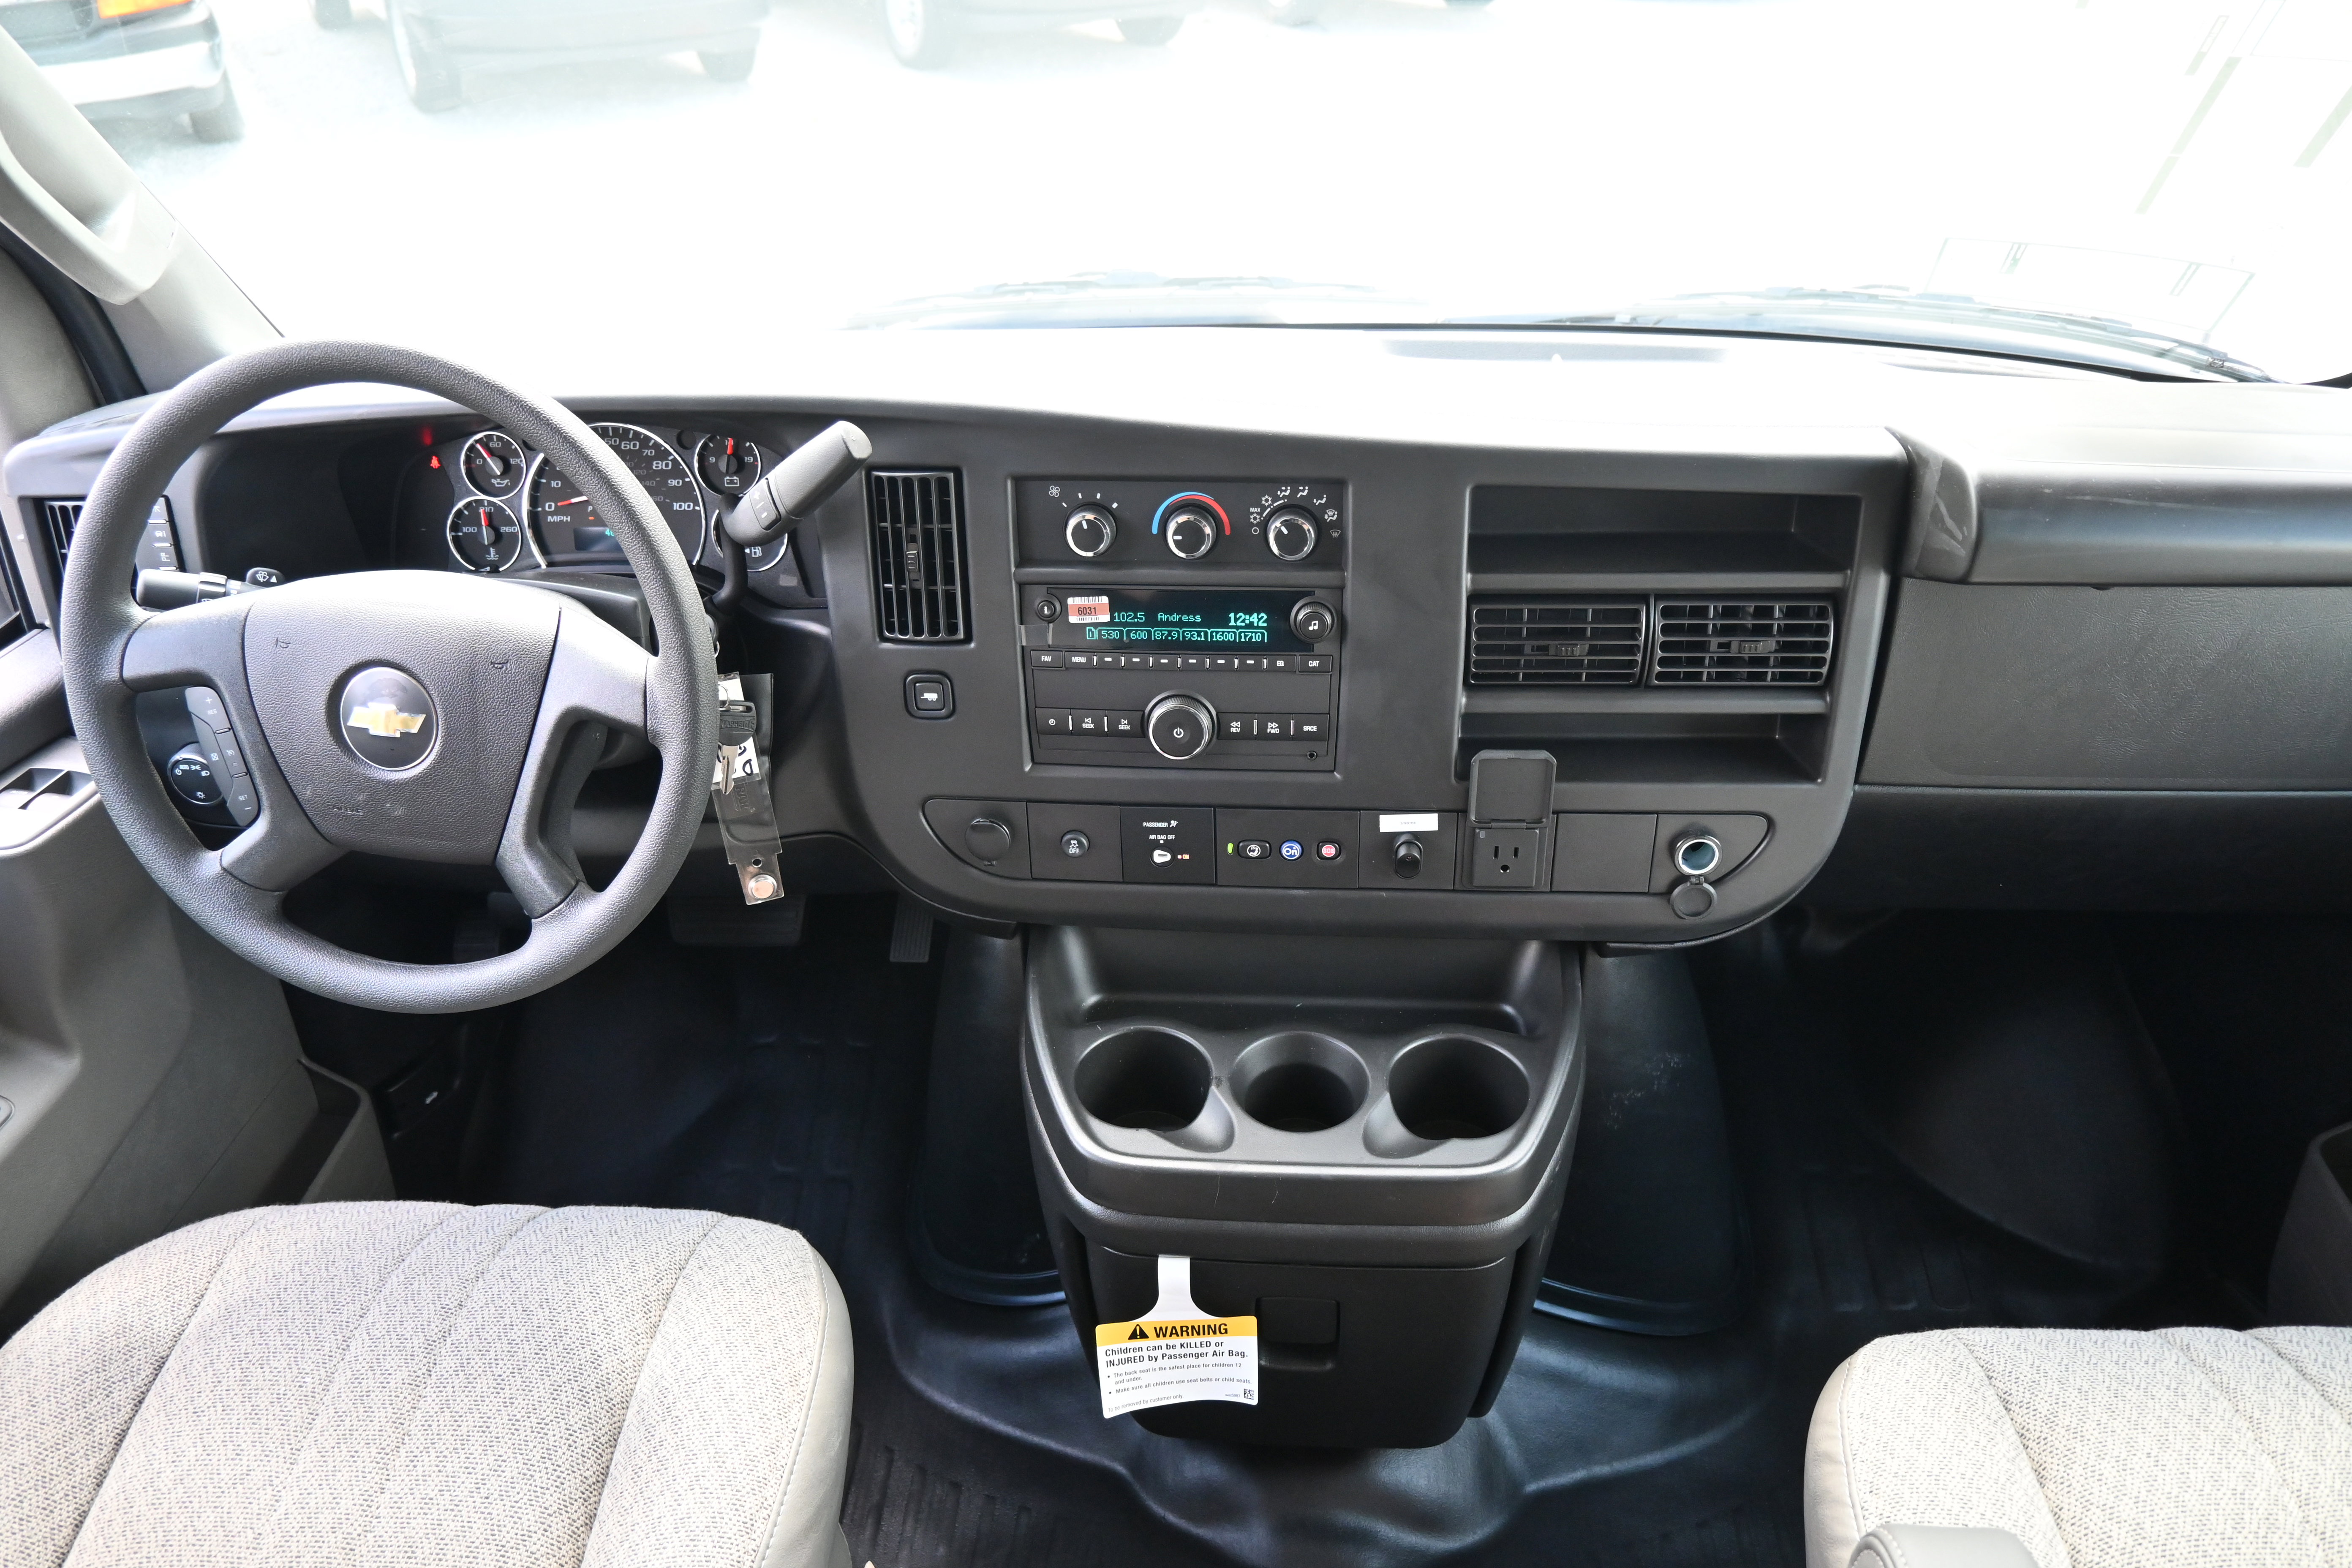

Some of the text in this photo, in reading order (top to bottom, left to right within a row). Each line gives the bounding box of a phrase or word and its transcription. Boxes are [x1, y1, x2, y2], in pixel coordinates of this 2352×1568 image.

[621, 441, 639, 449] 60
[652, 461, 672, 470] 80
[545, 502, 555, 511] 0
[672, 502, 693, 510] 100
[1078, 607, 1097, 615] 6031
[1113, 612, 1267, 626] 102.5 Andress 12:42
[1101, 631, 1119, 639] 530
[1130, 631, 1148, 639] 600
[1155, 631, 1178, 640] 87.9
[1184, 632, 1205, 640] 93.1
[1212, 632, 1234, 641] 1600
[1241, 633, 1262, 641] 1710
[1284, 847, 1297, 855] On
[1154, 1323, 1228, 1338] WARNING
[1105, 1347, 1143, 1357] Children
[1180, 1341, 1211, 1349] KILLED
[1106, 1355, 1144, 1367] INJURED
[1162, 1352, 1209, 1360] Passenger
[1228, 1350, 1248, 1358] Bag.
[1122, 1400, 1141, 1409] removed
